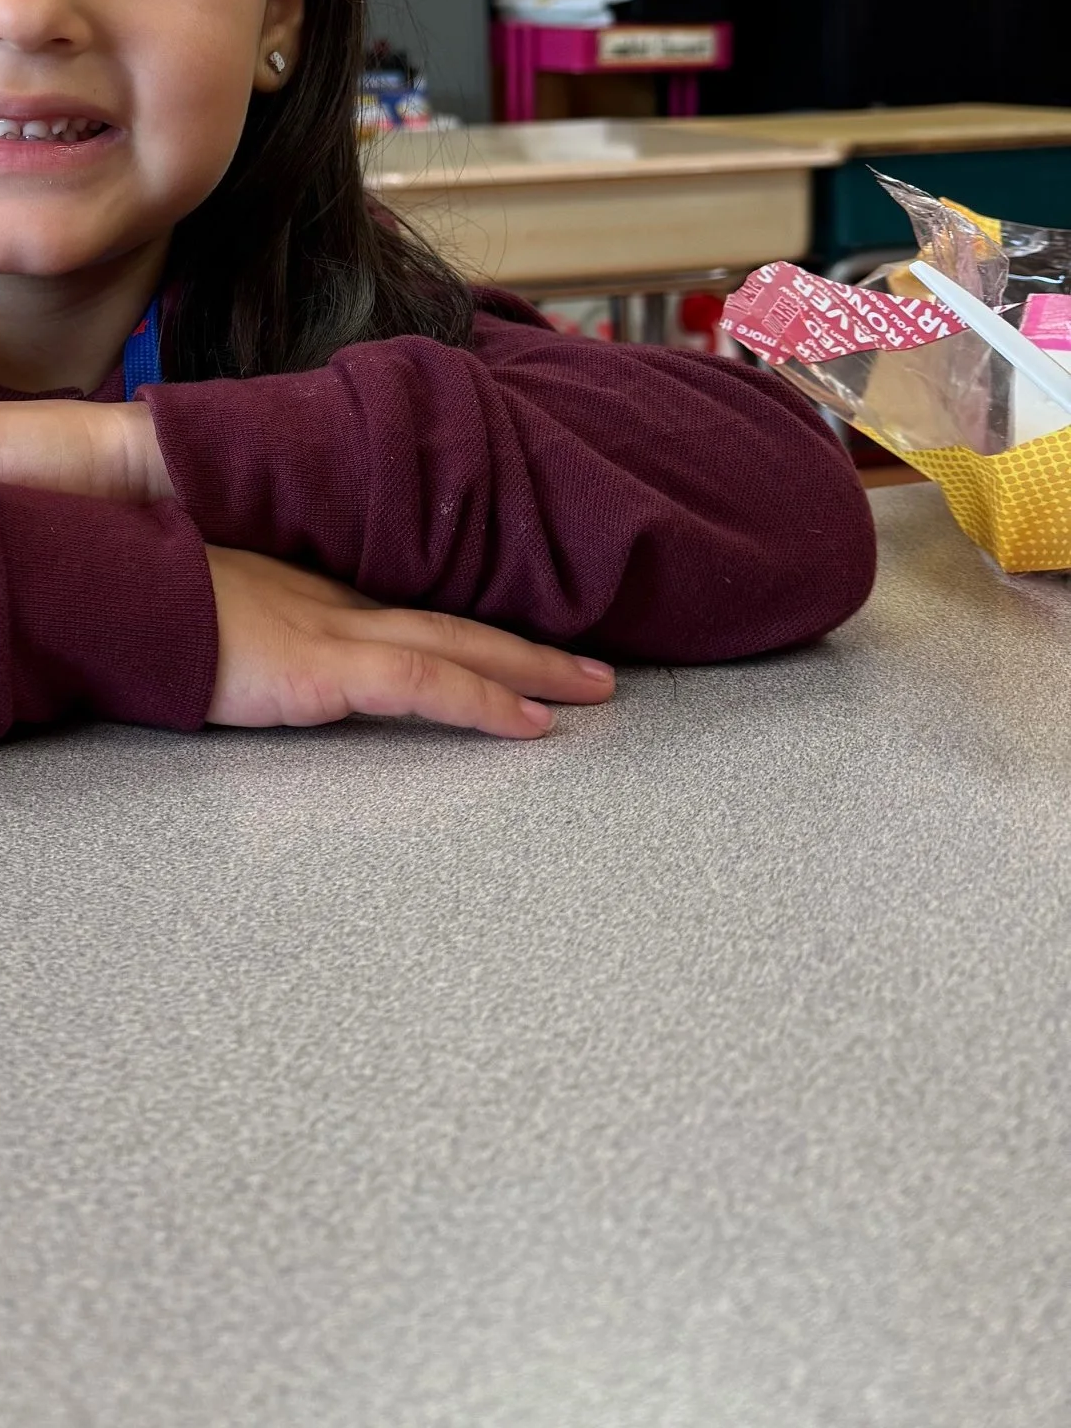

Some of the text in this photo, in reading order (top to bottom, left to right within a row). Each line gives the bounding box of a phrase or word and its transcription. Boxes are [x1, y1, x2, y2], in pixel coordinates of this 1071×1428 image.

[809, 311, 830, 330] you
[889, 314, 914, 334] you
[737, 322, 778, 347] more
